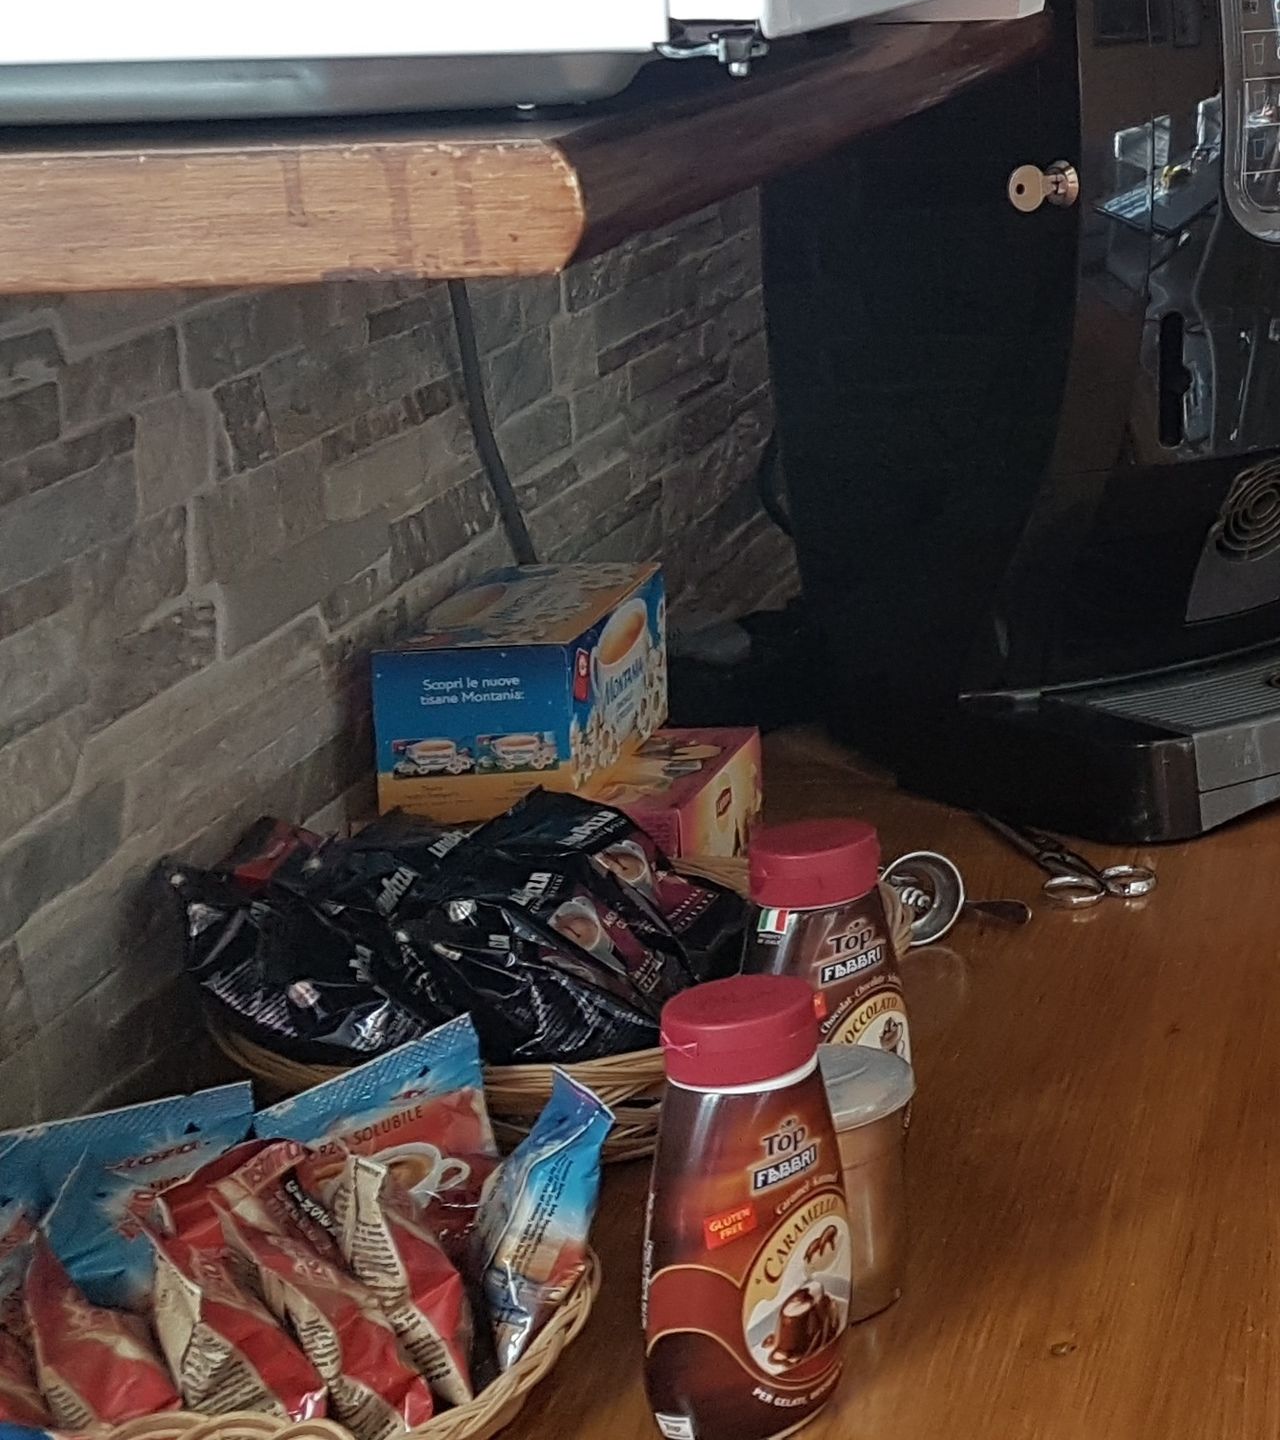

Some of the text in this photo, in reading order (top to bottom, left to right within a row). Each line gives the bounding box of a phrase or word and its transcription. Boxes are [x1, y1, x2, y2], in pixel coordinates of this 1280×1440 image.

[422, 676, 521, 691] Scopri le nuove
[420, 691, 458, 706] tisane
[830, 927, 872, 954] Top
[823, 947, 882, 982] FABBRI
[820, 996, 852, 1034] Chocolat
[352, 1106, 424, 1144] SOLUBILE
[763, 1126, 806, 1156] Top
[756, 1146, 817, 1188] FABBRI
[709, 1209, 751, 1232] GLUTEN
[720, 1224, 743, 1240] FREE
[763, 1197, 838, 1284] CARAMELLO
[752, 1387, 770, 1404] PER
